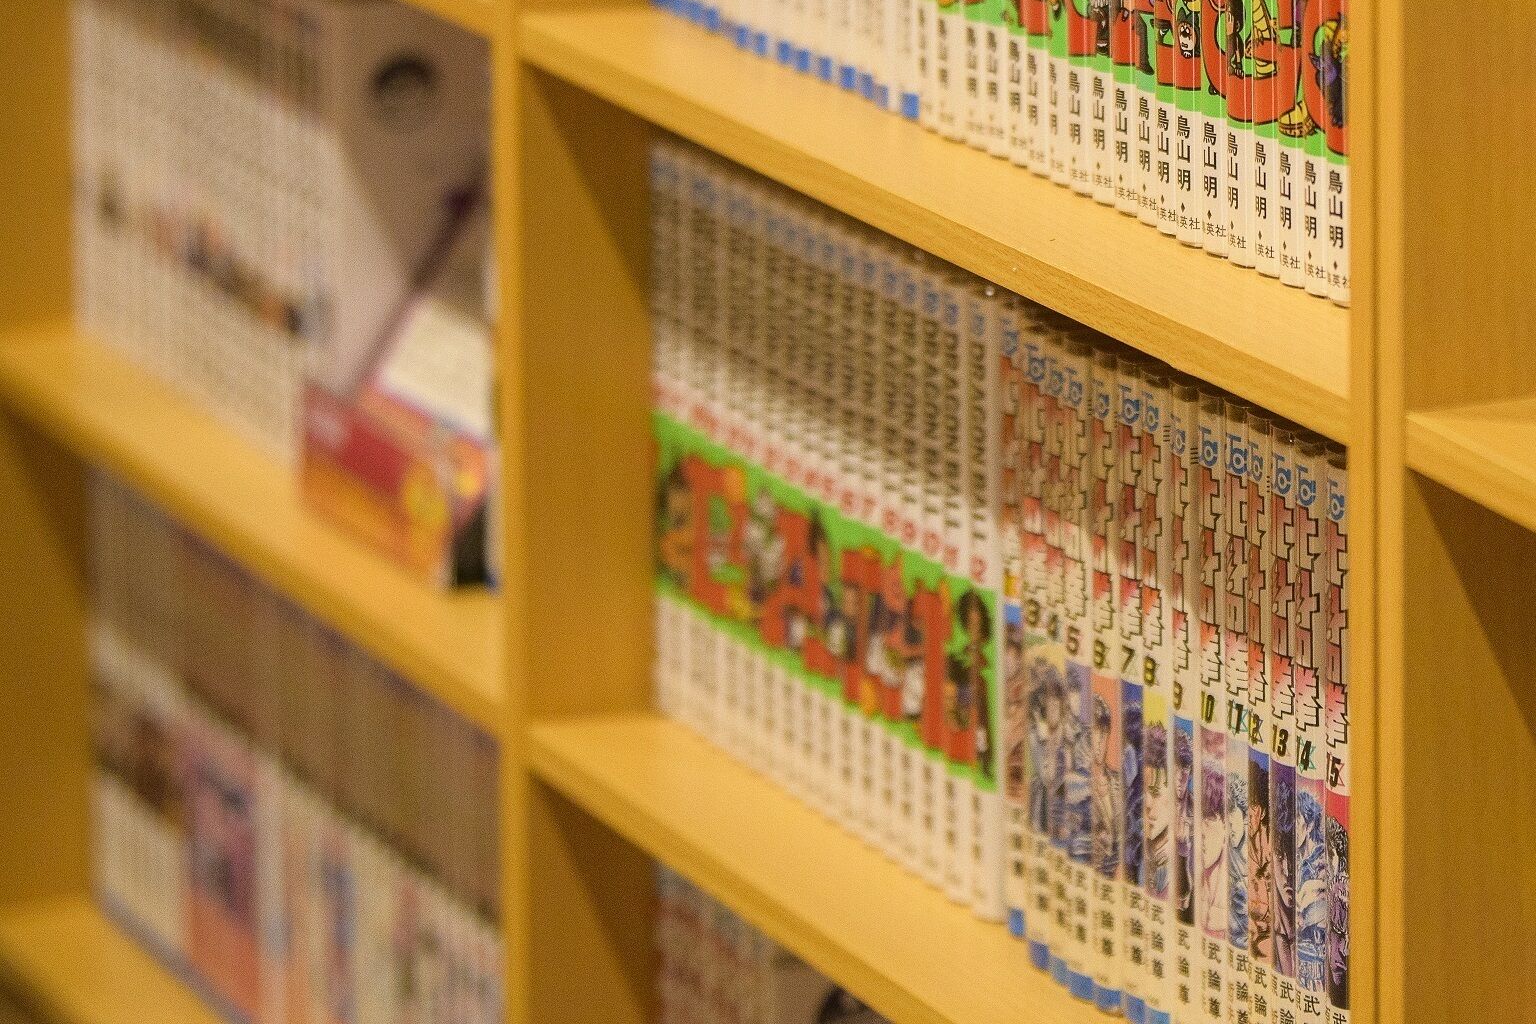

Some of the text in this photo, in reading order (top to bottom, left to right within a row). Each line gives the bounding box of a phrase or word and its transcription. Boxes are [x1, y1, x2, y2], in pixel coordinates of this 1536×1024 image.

[1093, 76, 1105, 152] 鳥山明
[1115, 88, 1128, 164] 鳥山明
[1138, 96, 1151, 173] 鳥山明
[1157, 107, 1170, 185] 鳥山明
[1177, 115, 1191, 193] 鳥山明
[1203, 121, 1218, 199] 鳥山明
[1227, 132, 1239, 210] 鳥山明
[1255, 141, 1267, 220] 鳥山明
[1280, 151, 1292, 230] 鳥山明
[1305, 160, 1317, 240] 鳥山明
[1329, 170, 1344, 249] 鳥山明
[1067, 626, 1080, 656] 5
[1122, 644, 1135, 673] 7
[1144, 656, 1156, 686] 8
[1173, 681, 1182, 710] 9
[1201, 691, 1215, 723] 10
[1228, 699, 1244, 734] 11
[1273, 724, 1288, 757] 13
[1296, 735, 1312, 771] 14
[1327, 752, 1341, 787] 15
